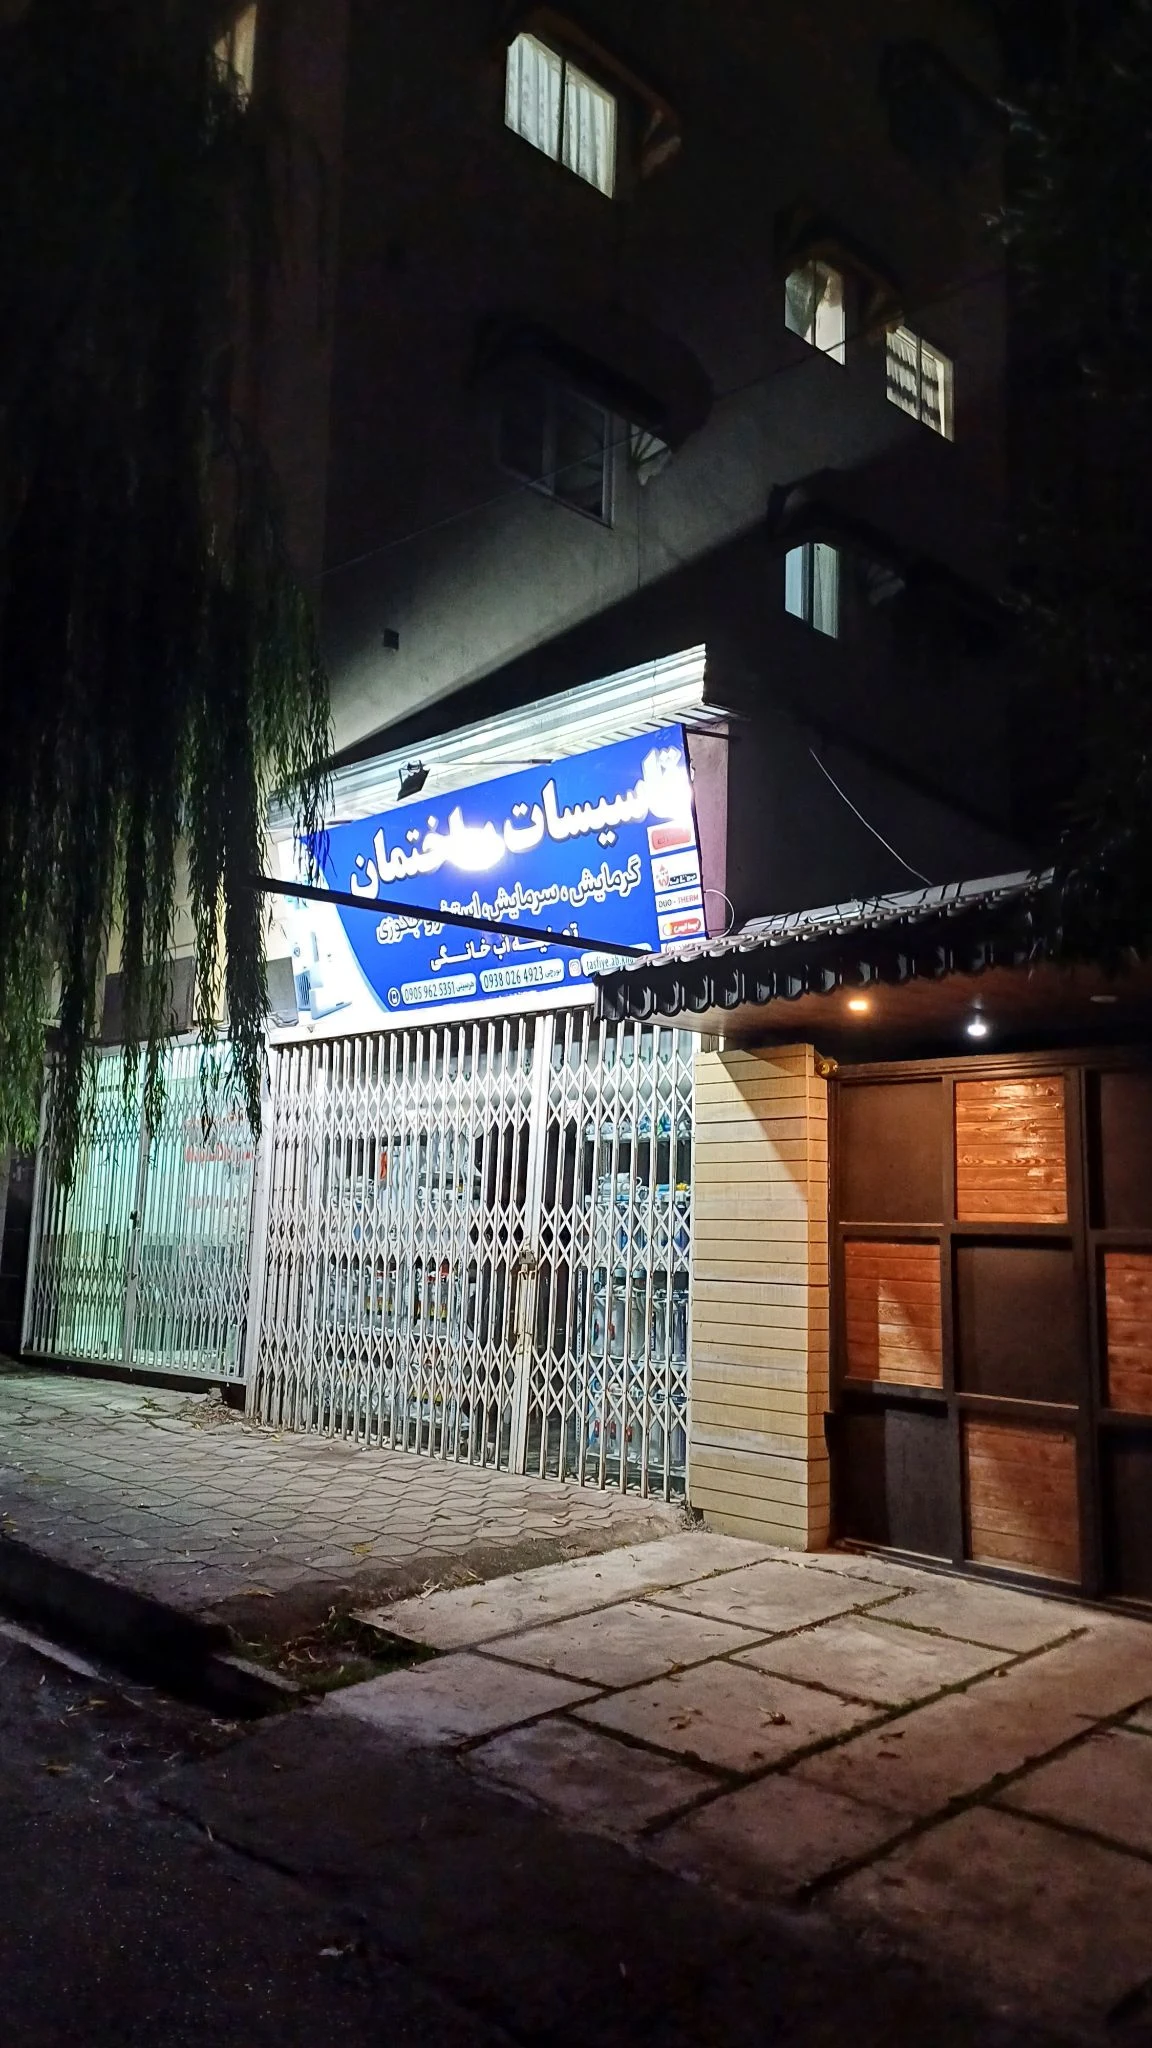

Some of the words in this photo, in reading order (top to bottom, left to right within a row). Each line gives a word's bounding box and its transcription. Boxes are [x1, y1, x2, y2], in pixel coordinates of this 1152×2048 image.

[658, 899, 672, 908] DUO
[677, 894, 699, 904] THERM
[483, 972, 503, 989] 0938
[506, 970, 521, 986] 026
[523, 966, 544, 983] 4923
[404, 986, 422, 1002] 0905
[423, 983, 438, 999] 962
[439, 981, 455, 996] 5351
